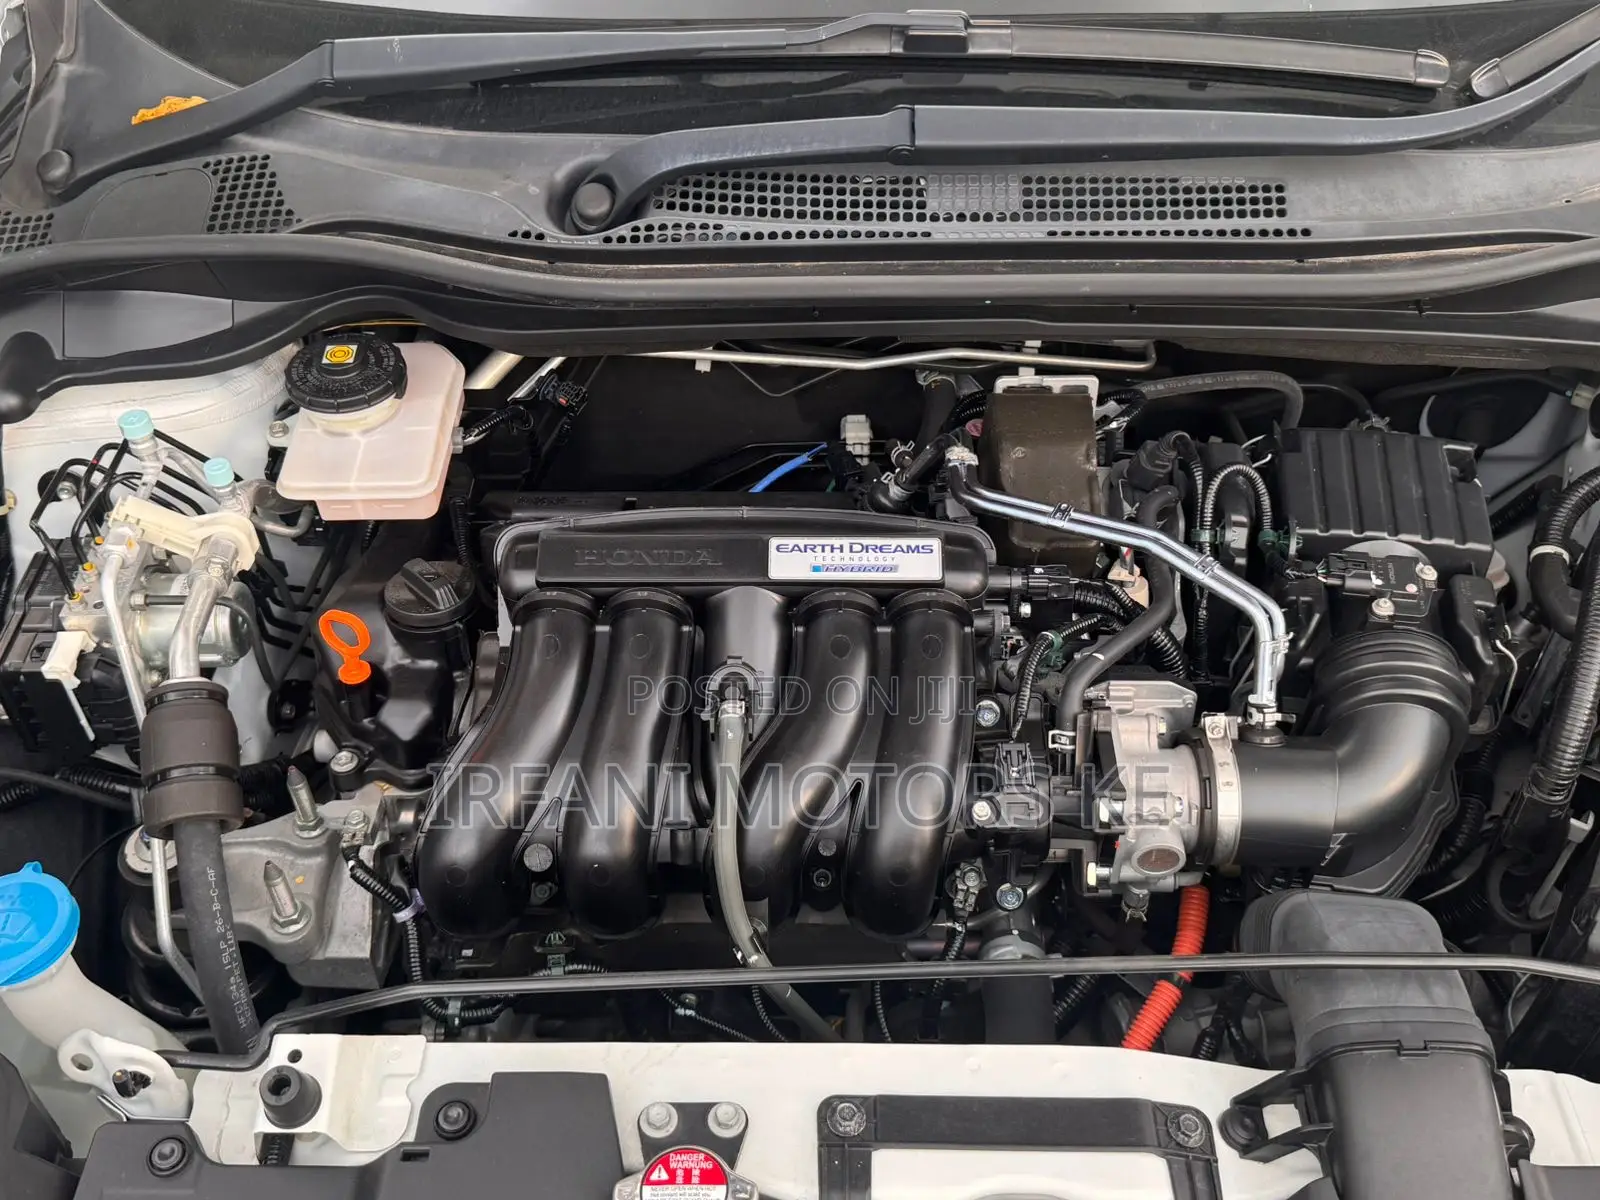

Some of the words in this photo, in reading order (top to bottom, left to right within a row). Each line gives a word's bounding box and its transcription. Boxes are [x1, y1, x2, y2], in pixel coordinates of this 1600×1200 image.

[775, 542, 844, 554] EARTH
[850, 542, 934, 554] DREAMS
[574, 549, 723, 566] HONDA
[824, 565, 894, 573] HYBRID
[206, 866, 225, 933] 26-B-C-AF
[669, 1160, 713, 1168] WARNUNG
